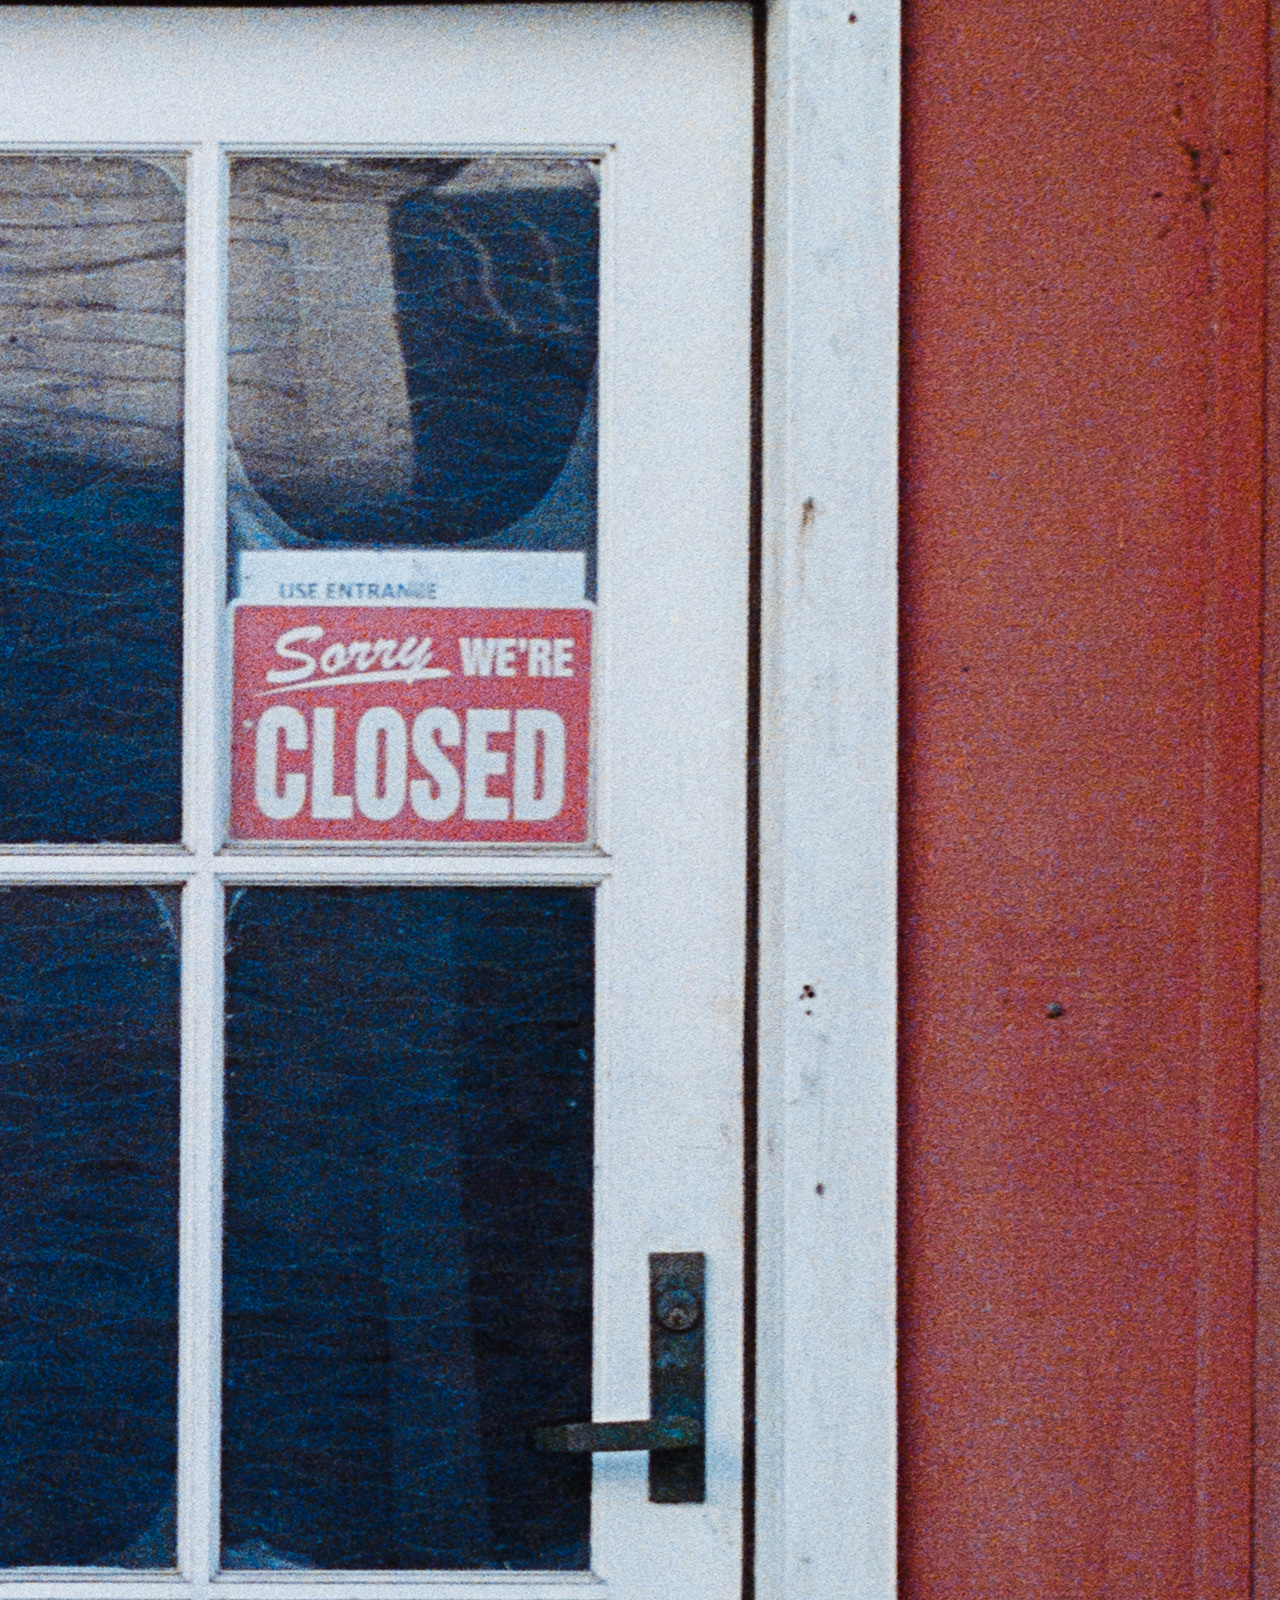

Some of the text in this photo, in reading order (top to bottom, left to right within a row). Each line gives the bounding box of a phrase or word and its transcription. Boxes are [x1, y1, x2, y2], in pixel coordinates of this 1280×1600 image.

[279, 583, 437, 600] USE ENTRANE
[264, 625, 575, 686] Sorry WE'RE
[253, 705, 567, 822] CLOSED
